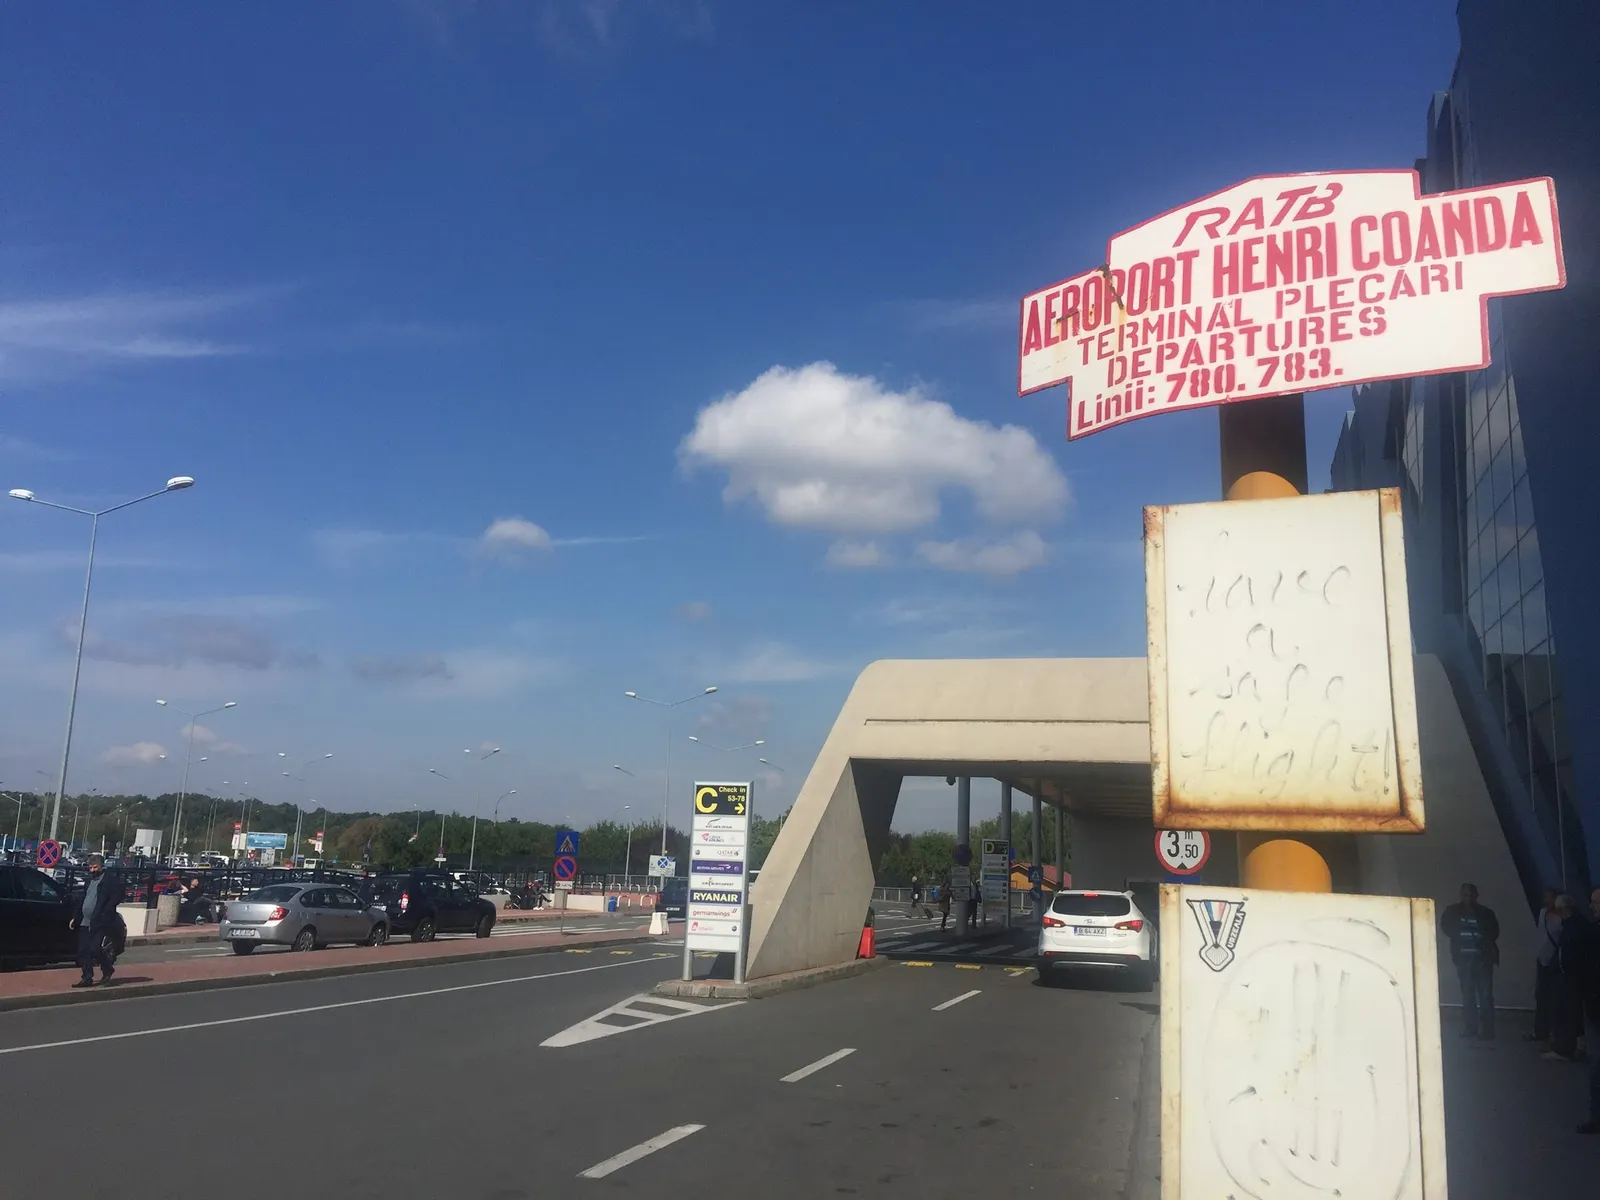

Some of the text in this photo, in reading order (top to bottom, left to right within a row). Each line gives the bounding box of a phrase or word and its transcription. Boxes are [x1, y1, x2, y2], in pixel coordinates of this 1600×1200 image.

[1172, 183, 1343, 247] RATB
[1023, 191, 1543, 356] AEROPORT HENRI COANDA
[1077, 299, 1253, 365] TERMINAL
[1107, 306, 1387, 388] DEPARTURES
[1077, 348, 1343, 430] Linii: 780. 783.
[696, 787, 718, 813] C
[985, 841, 994, 854] D
[693, 892, 738, 902] RYANAIR
